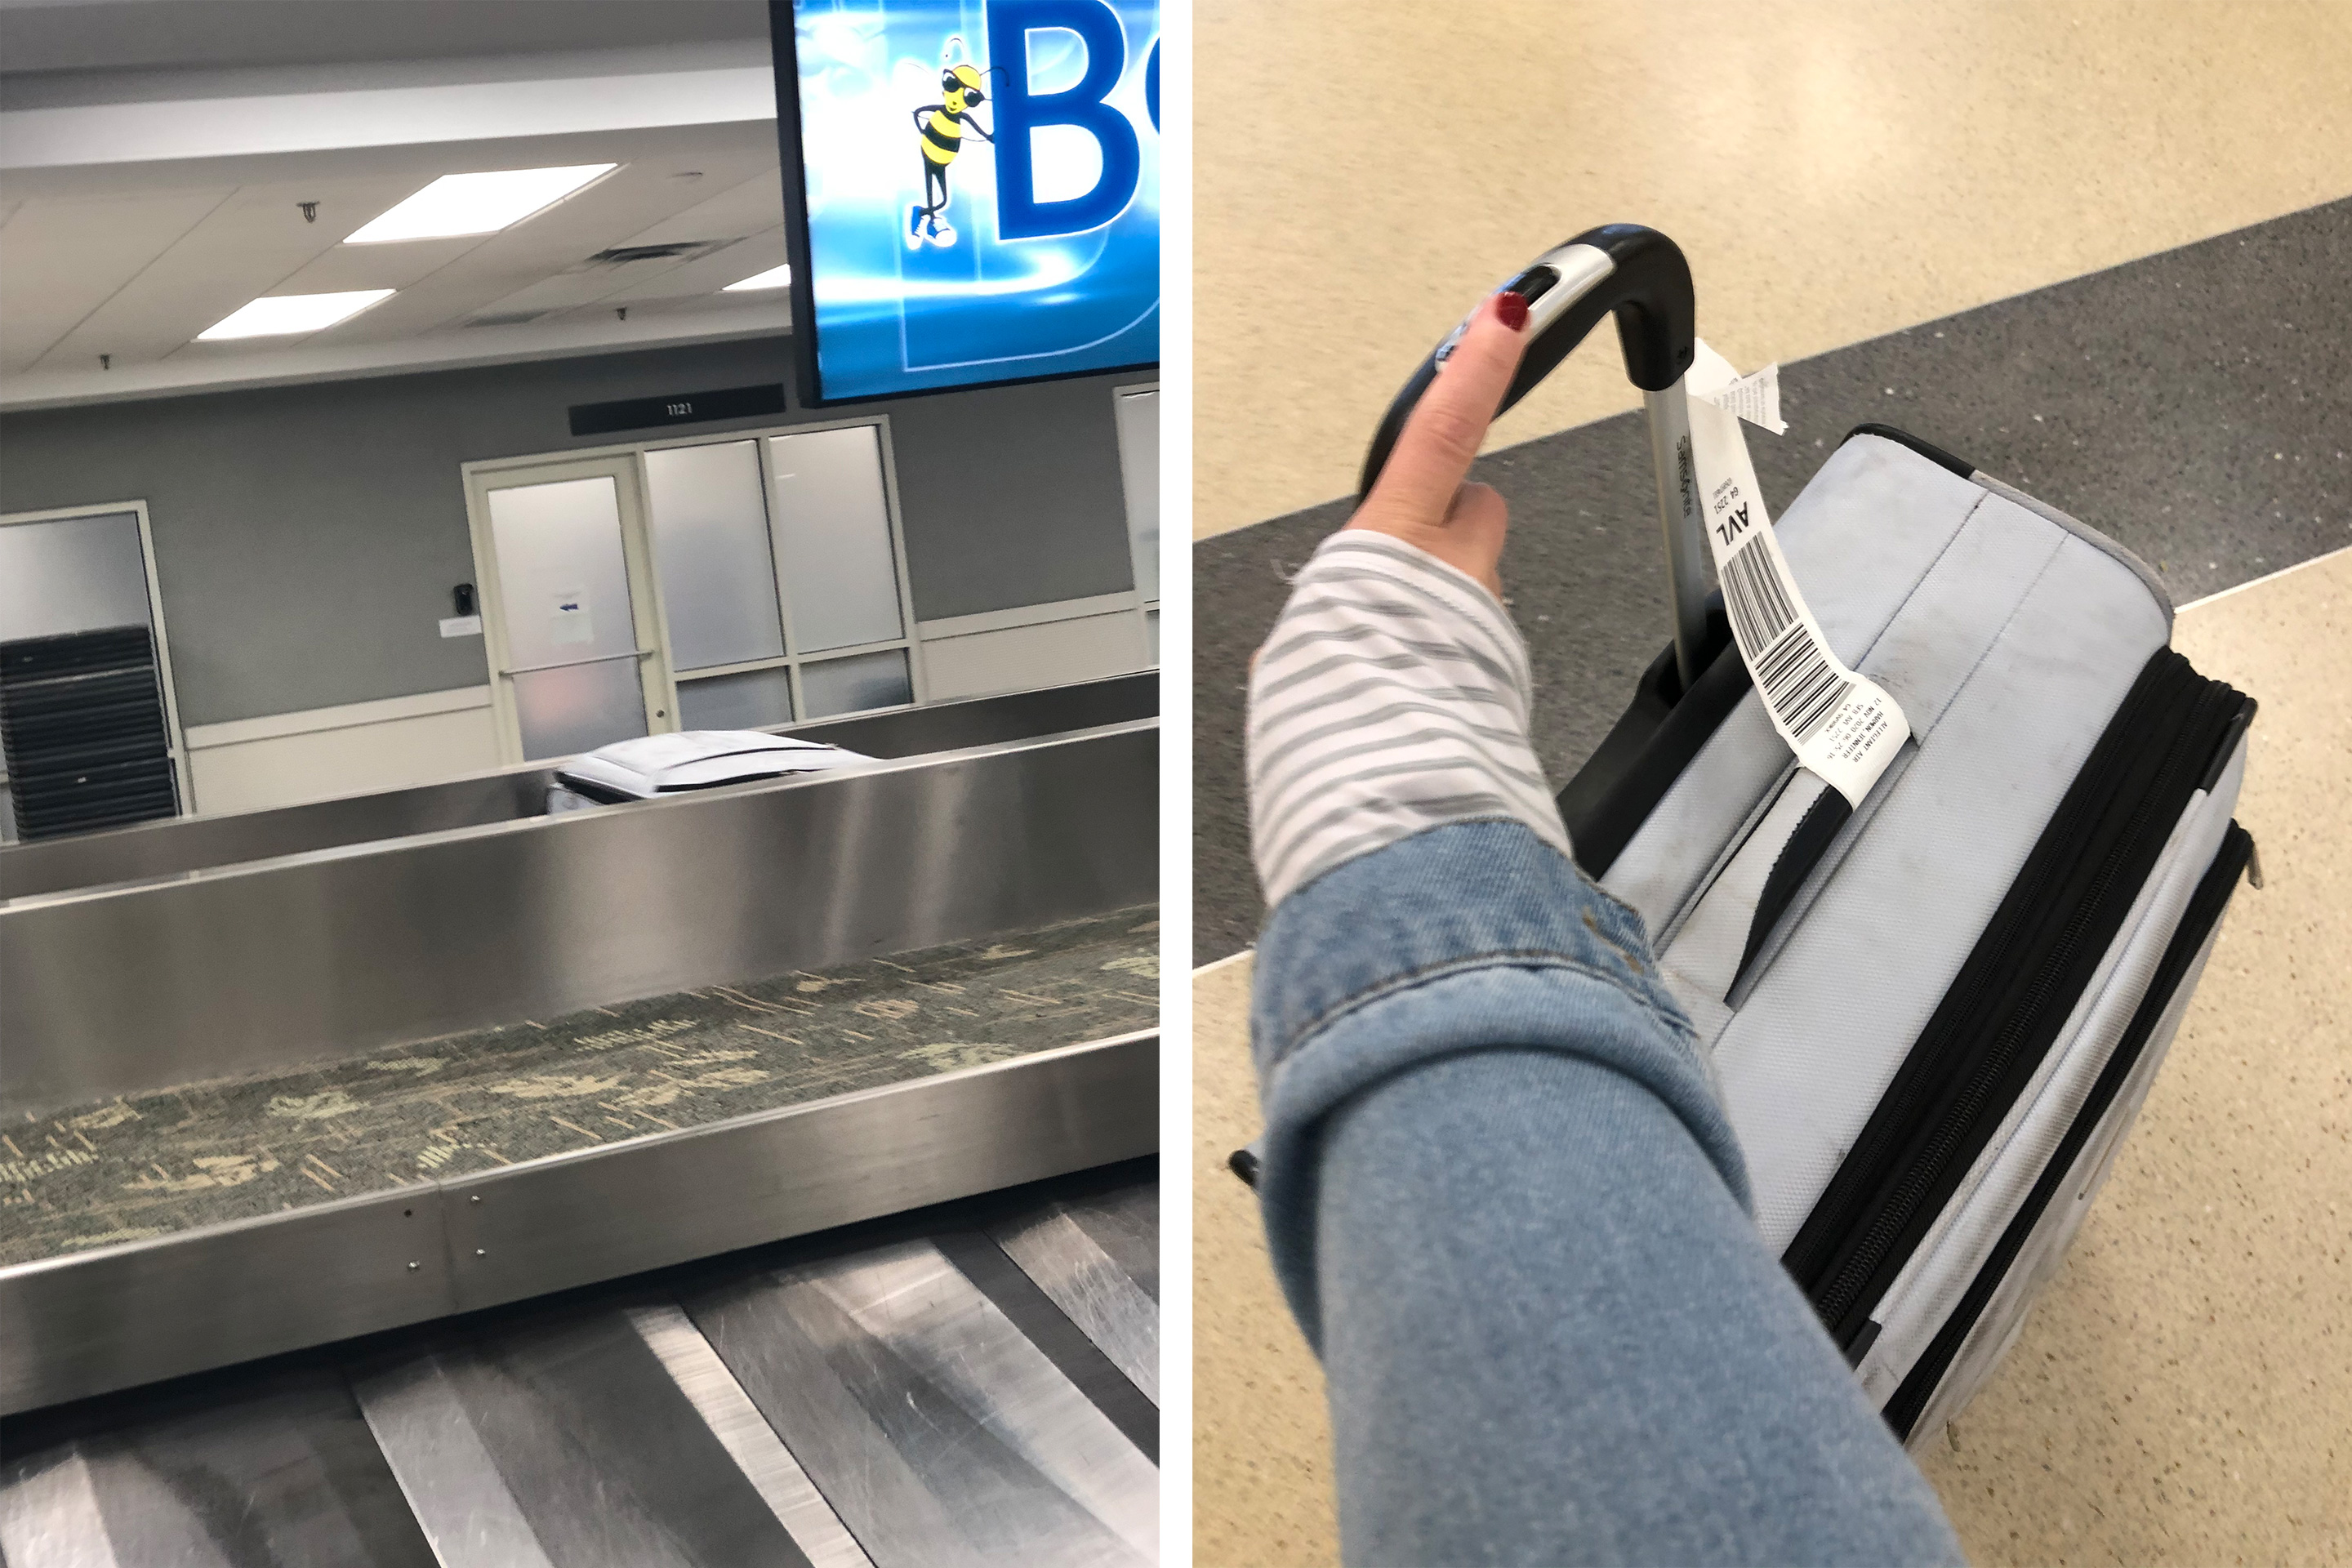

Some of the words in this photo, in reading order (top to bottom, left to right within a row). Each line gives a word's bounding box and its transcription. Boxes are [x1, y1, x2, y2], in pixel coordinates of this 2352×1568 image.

[986, 0, 1160, 241] B
[667, 403, 693, 415] 1121
[1676, 435, 1691, 519] Samsonite
[1713, 495, 1729, 514] 2251
[1716, 501, 1749, 546] AVL
[1863, 706, 1875, 718] NOV
[1850, 718, 1864, 733] 2020
[1851, 751, 1864, 763] AIR
